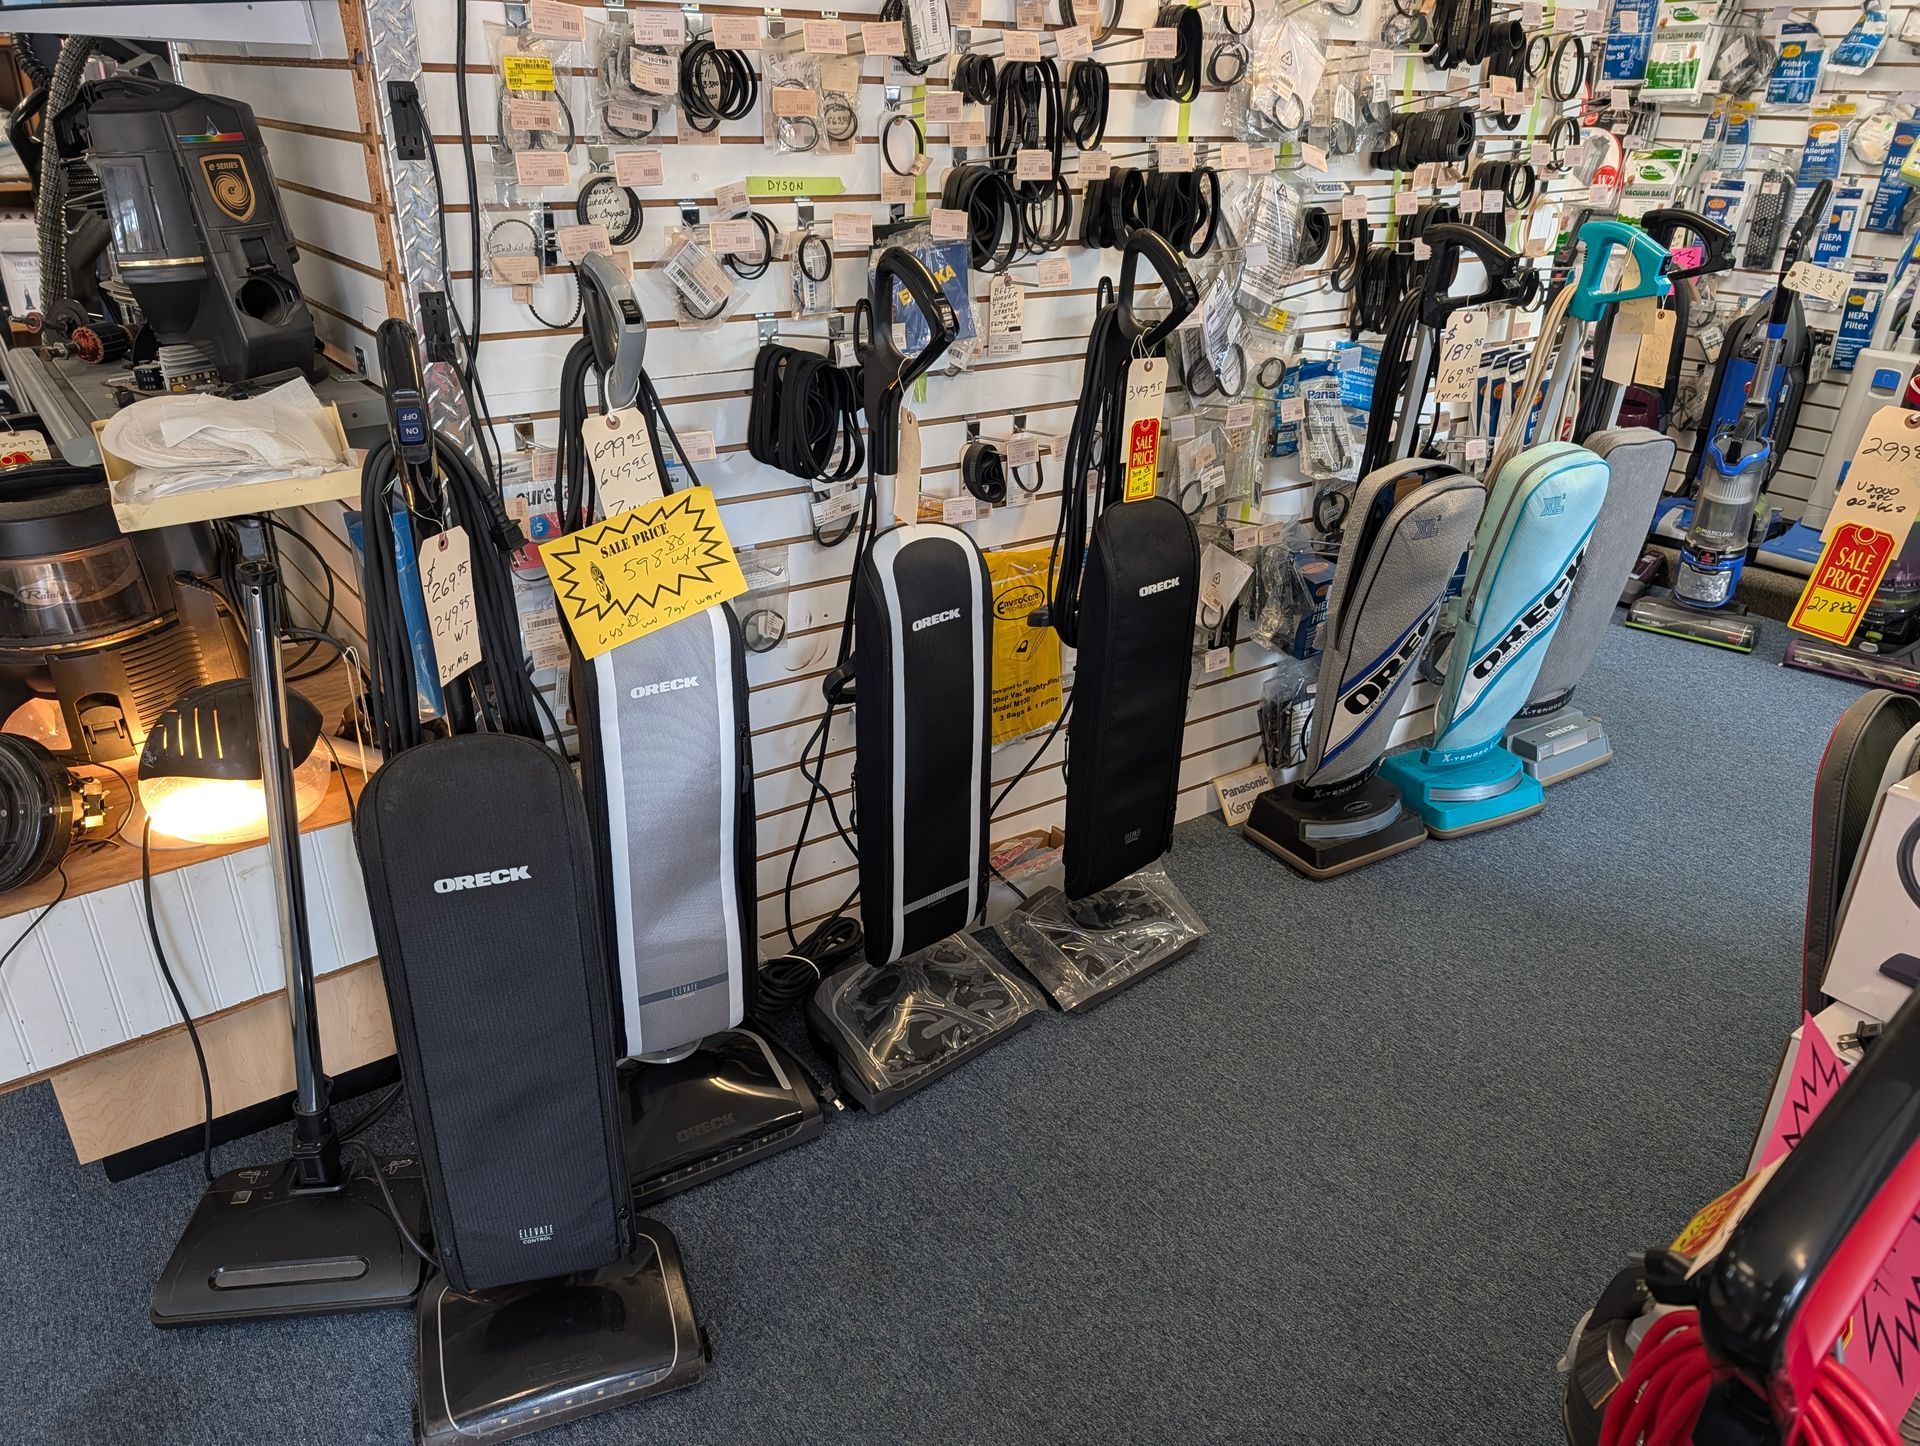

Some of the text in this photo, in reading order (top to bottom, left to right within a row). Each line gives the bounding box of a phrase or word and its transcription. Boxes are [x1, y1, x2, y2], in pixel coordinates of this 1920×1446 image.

[1656, 31, 1704, 40] VACUUM BAGS
[1780, 60, 1810, 68] Primary
[1783, 68, 1802, 77] Filter
[1804, 147, 1835, 155] Allergen
[216, 161, 239, 170] SERIES
[767, 179, 804, 192] DYSON
[1821, 233, 1842, 242] HEPA
[1818, 242, 1841, 252] Filter
[1847, 312, 1869, 321] HEPA
[1445, 323, 1457, 344] $
[1844, 321, 1868, 331] Filter
[402, 412, 418, 421] OFF
[405, 427, 419, 435] ON
[1134, 433, 1154, 452] SALE
[1132, 449, 1154, 467] PRICE
[600, 522, 670, 559] SALE PRICE
[1834, 546, 1876, 574] SALE
[1138, 576, 1181, 598] ORECK
[1822, 566, 1870, 597] PRICE
[997, 590, 1040, 615] EnviroCare
[912, 607, 962, 632] ORECK
[630, 675, 700, 699] ORECK
[992, 694, 1009, 706] Shop
[993, 701, 1012, 714] Model
[1006, 708, 1025, 720] Bags
[1520, 701, 1562, 716] X-TENDED
[1545, 723, 1579, 739] ORECK
[1441, 747, 1489, 764] X-TENDED
[1220, 774, 1270, 800] Panasonic
[1313, 779, 1363, 799] X-TENDED
[432, 864, 533, 895] ORECK
[671, 982, 699, 997] ELEVATE
[519, 1224, 554, 1239] ELEVATE
[522, 1236, 553, 1245] CONTROL
